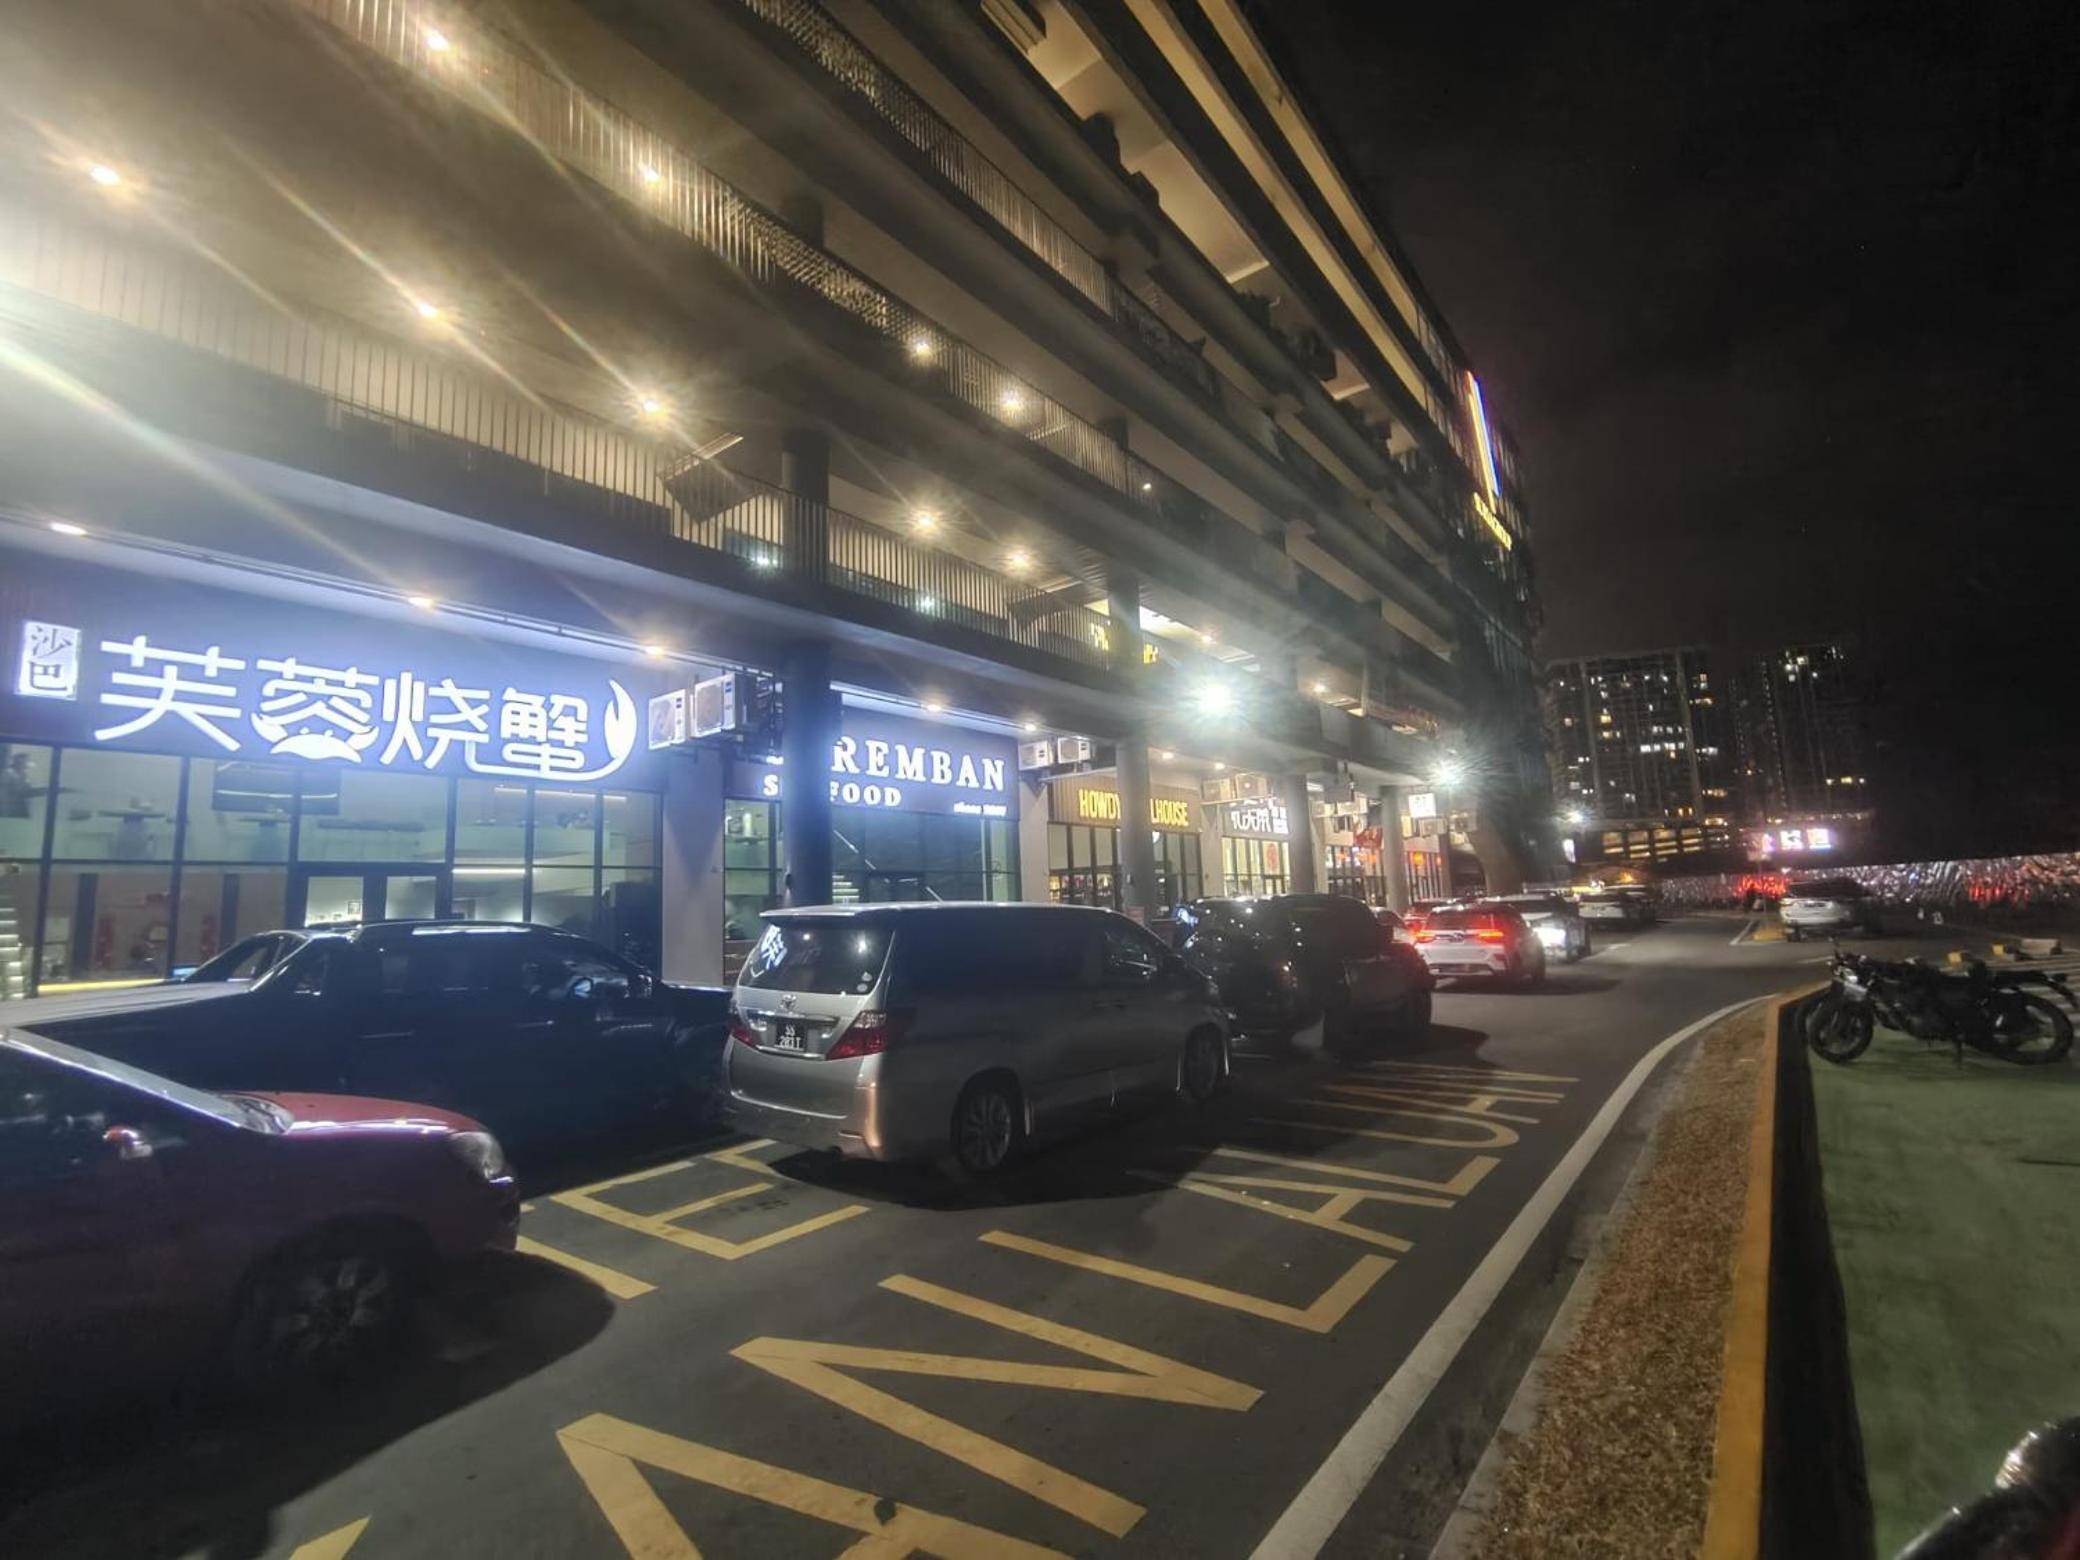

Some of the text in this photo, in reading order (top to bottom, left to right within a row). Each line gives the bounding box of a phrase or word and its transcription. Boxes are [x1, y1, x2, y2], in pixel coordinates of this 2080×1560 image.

[27, 624, 74, 695] 沙巴
[95, 635, 637, 782] 芙蓉烧蟹
[831, 736, 1005, 791] REMBAN
